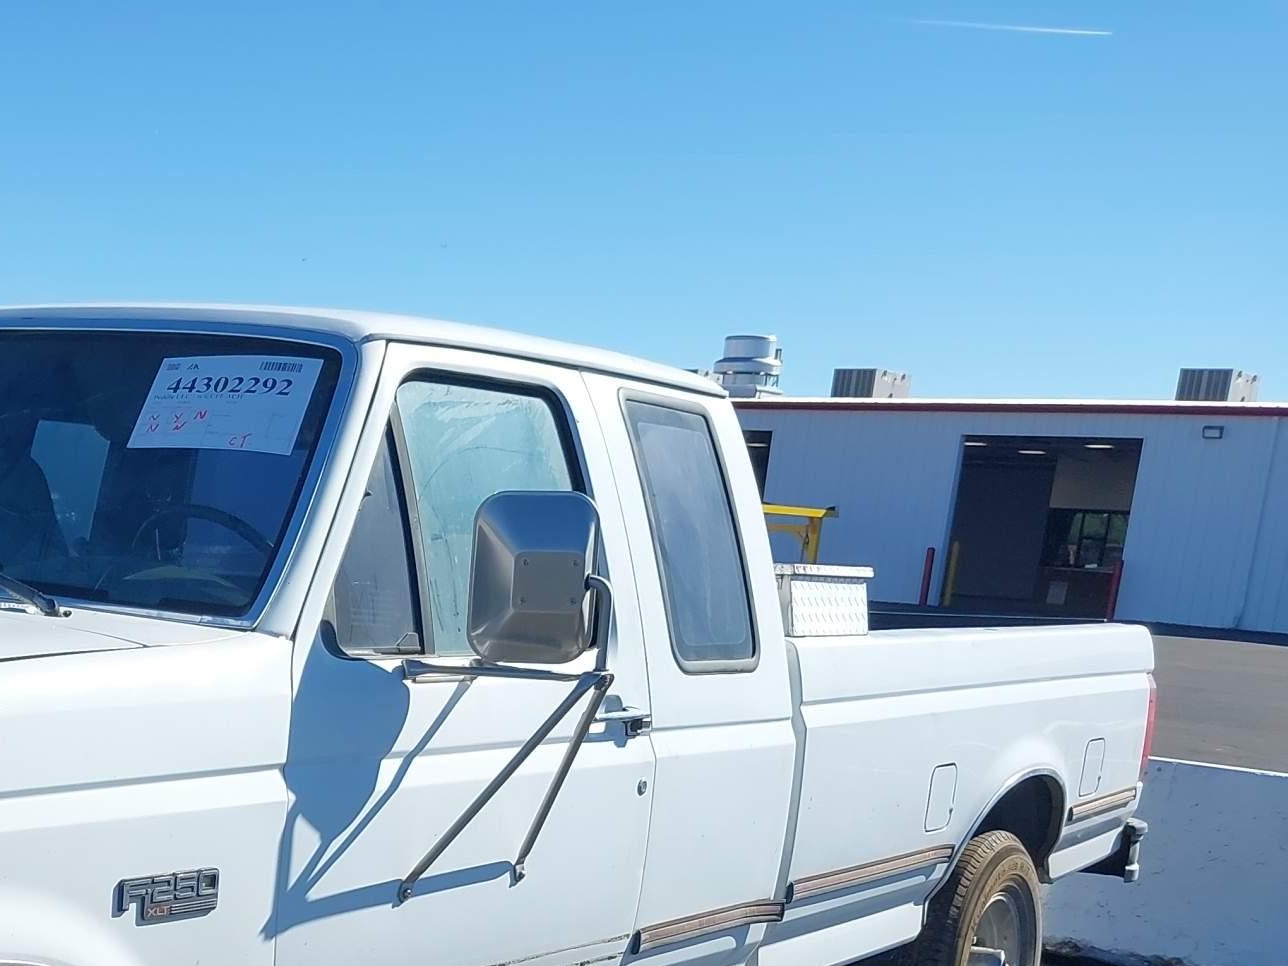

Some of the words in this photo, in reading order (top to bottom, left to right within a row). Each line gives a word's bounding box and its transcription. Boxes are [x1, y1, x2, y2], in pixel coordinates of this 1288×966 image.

[166, 376, 294, 396] 44302292
[116, 867, 220, 912] F250
[146, 904, 171, 918] XLT
